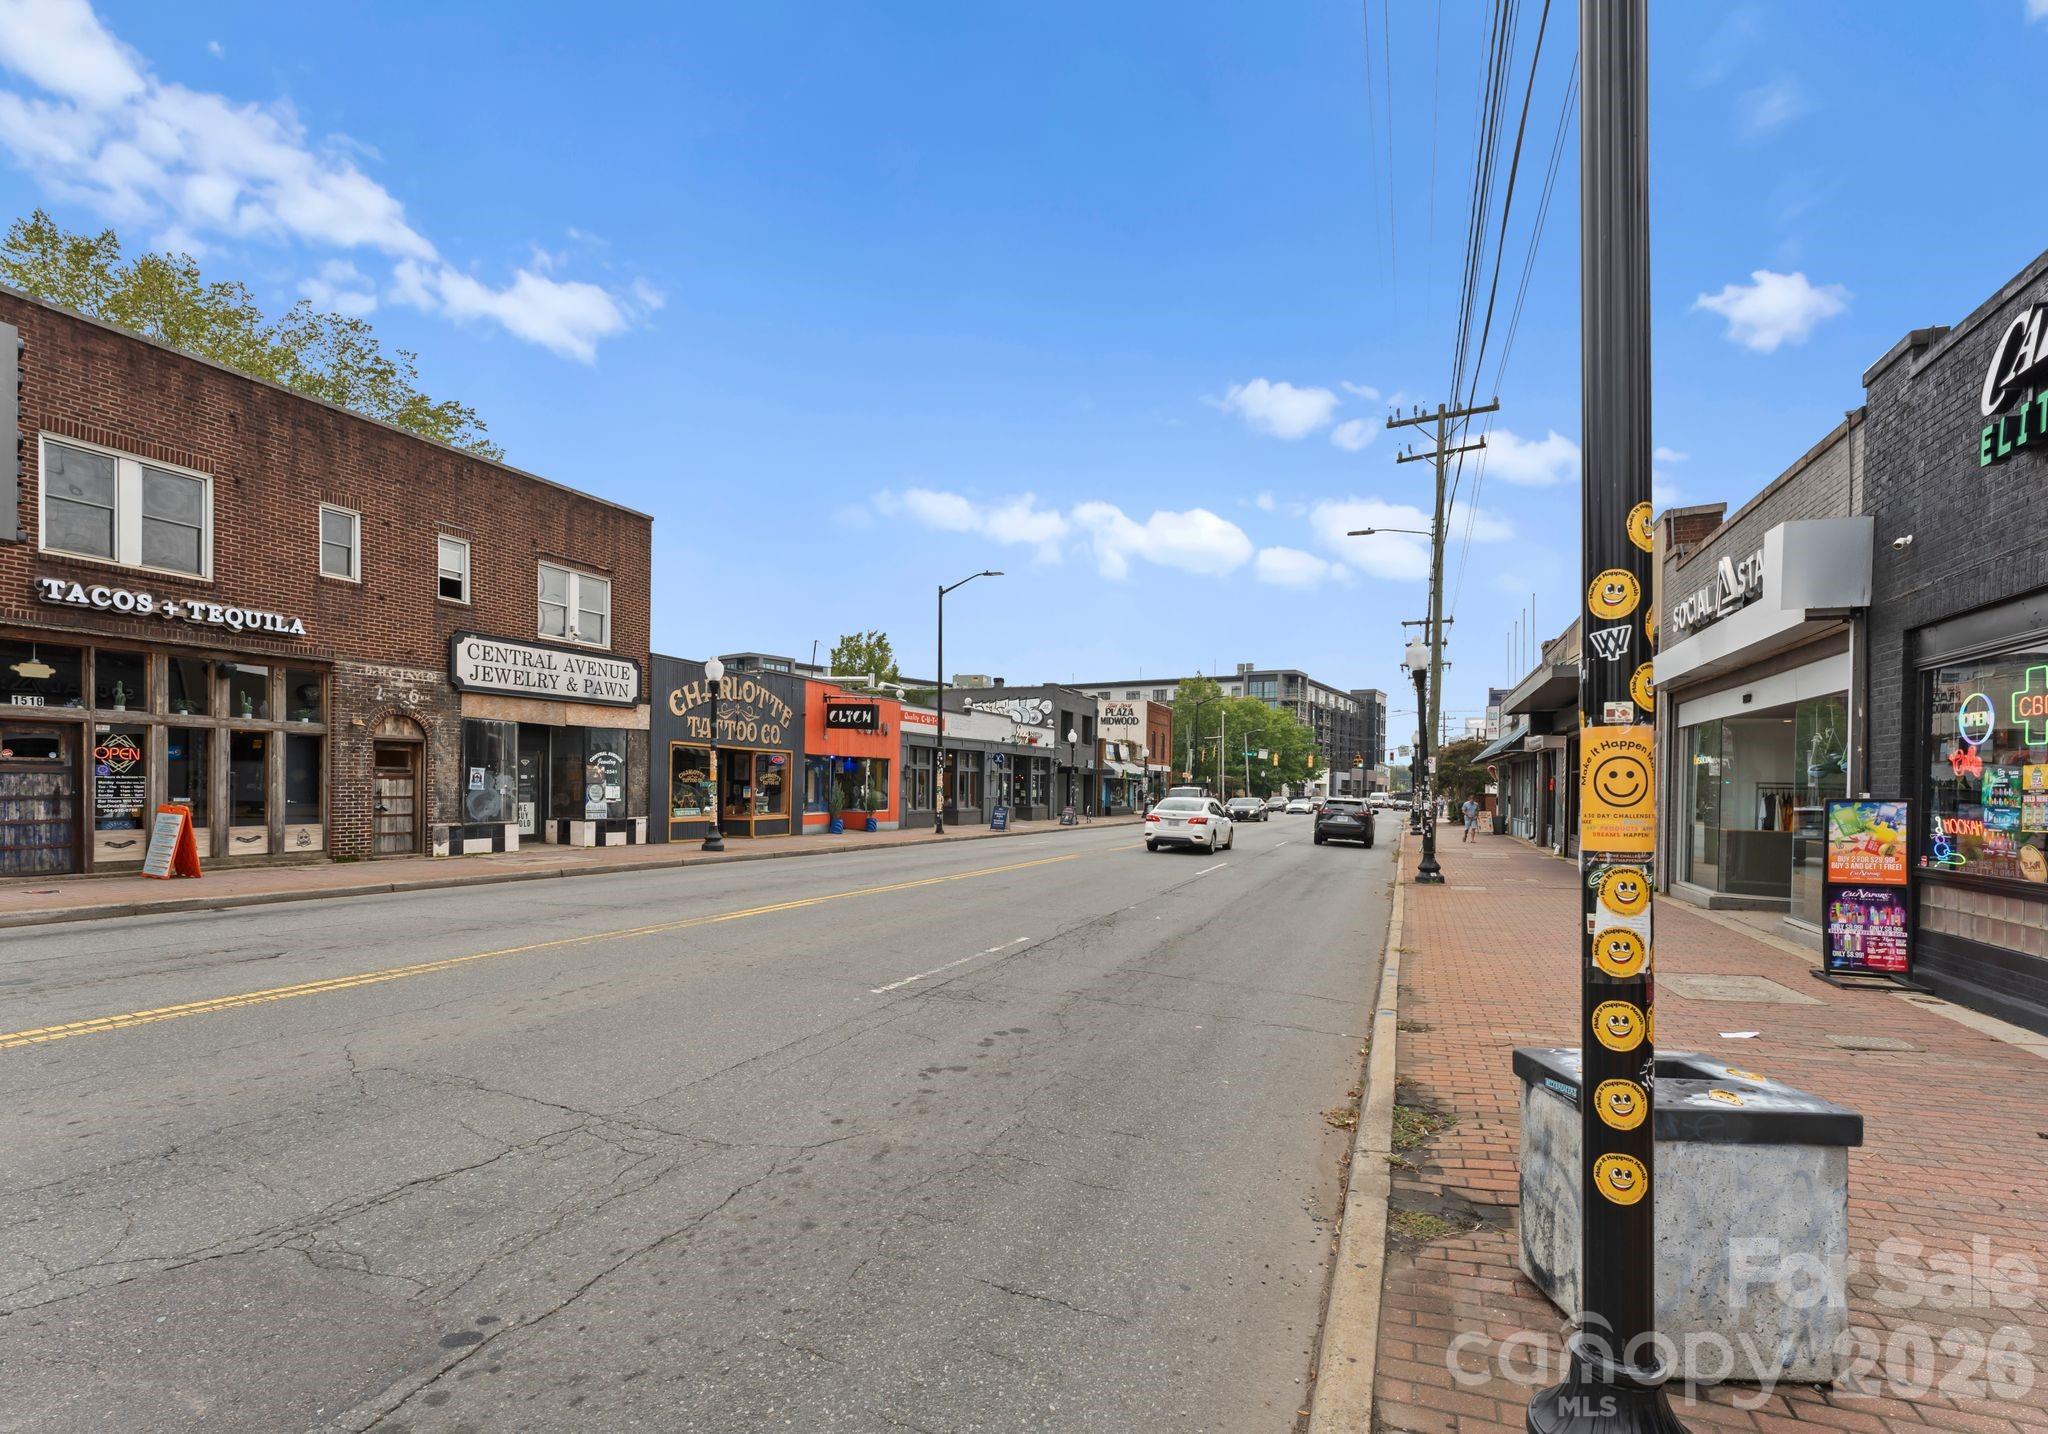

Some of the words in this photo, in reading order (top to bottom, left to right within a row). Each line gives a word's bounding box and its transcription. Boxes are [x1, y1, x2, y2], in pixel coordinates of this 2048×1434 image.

[43, 579, 153, 612] TACOS
[163, 601, 179, 616] +
[187, 601, 306, 635] TEQUILA
[1672, 586, 1713, 632] SOCIAL
[467, 643, 557, 671] CENTRAL
[563, 658, 630, 680] AVENUE
[469, 664, 561, 690] JEWELRY
[566, 677, 578, 692] &
[584, 678, 629, 698] PAWN
[409, 690, 419, 703] 6
[668, 676, 793, 728] CHARLOTTE
[904, 712, 920, 722] Quality
[1100, 717, 1139, 725] MIDWOOD
[1105, 708, 1134, 716] PLAZA
[686, 716, 758, 742] TATTOO
[760, 723, 782, 744] CO.
[94, 746, 140, 760] OPEN
[589, 752, 607, 763] CENTRAL
[1581, 757, 1592, 786] Make
[1590, 747, 1600, 756] It
[1600, 740, 1647, 753] Happen
[518, 812, 528, 820] UY
[519, 820, 531, 828] OLD
[1943, 819, 1984, 836] HOOKAH
[1600, 880, 1608, 896] Make
[1632, 933, 1645, 952] Month
[1630, 1006, 1643, 1025] Month
[1631, 1084, 1645, 1103] Month
[1606, 1155, 1634, 1163] Happen
[1634, 1161, 1647, 1181] Month
